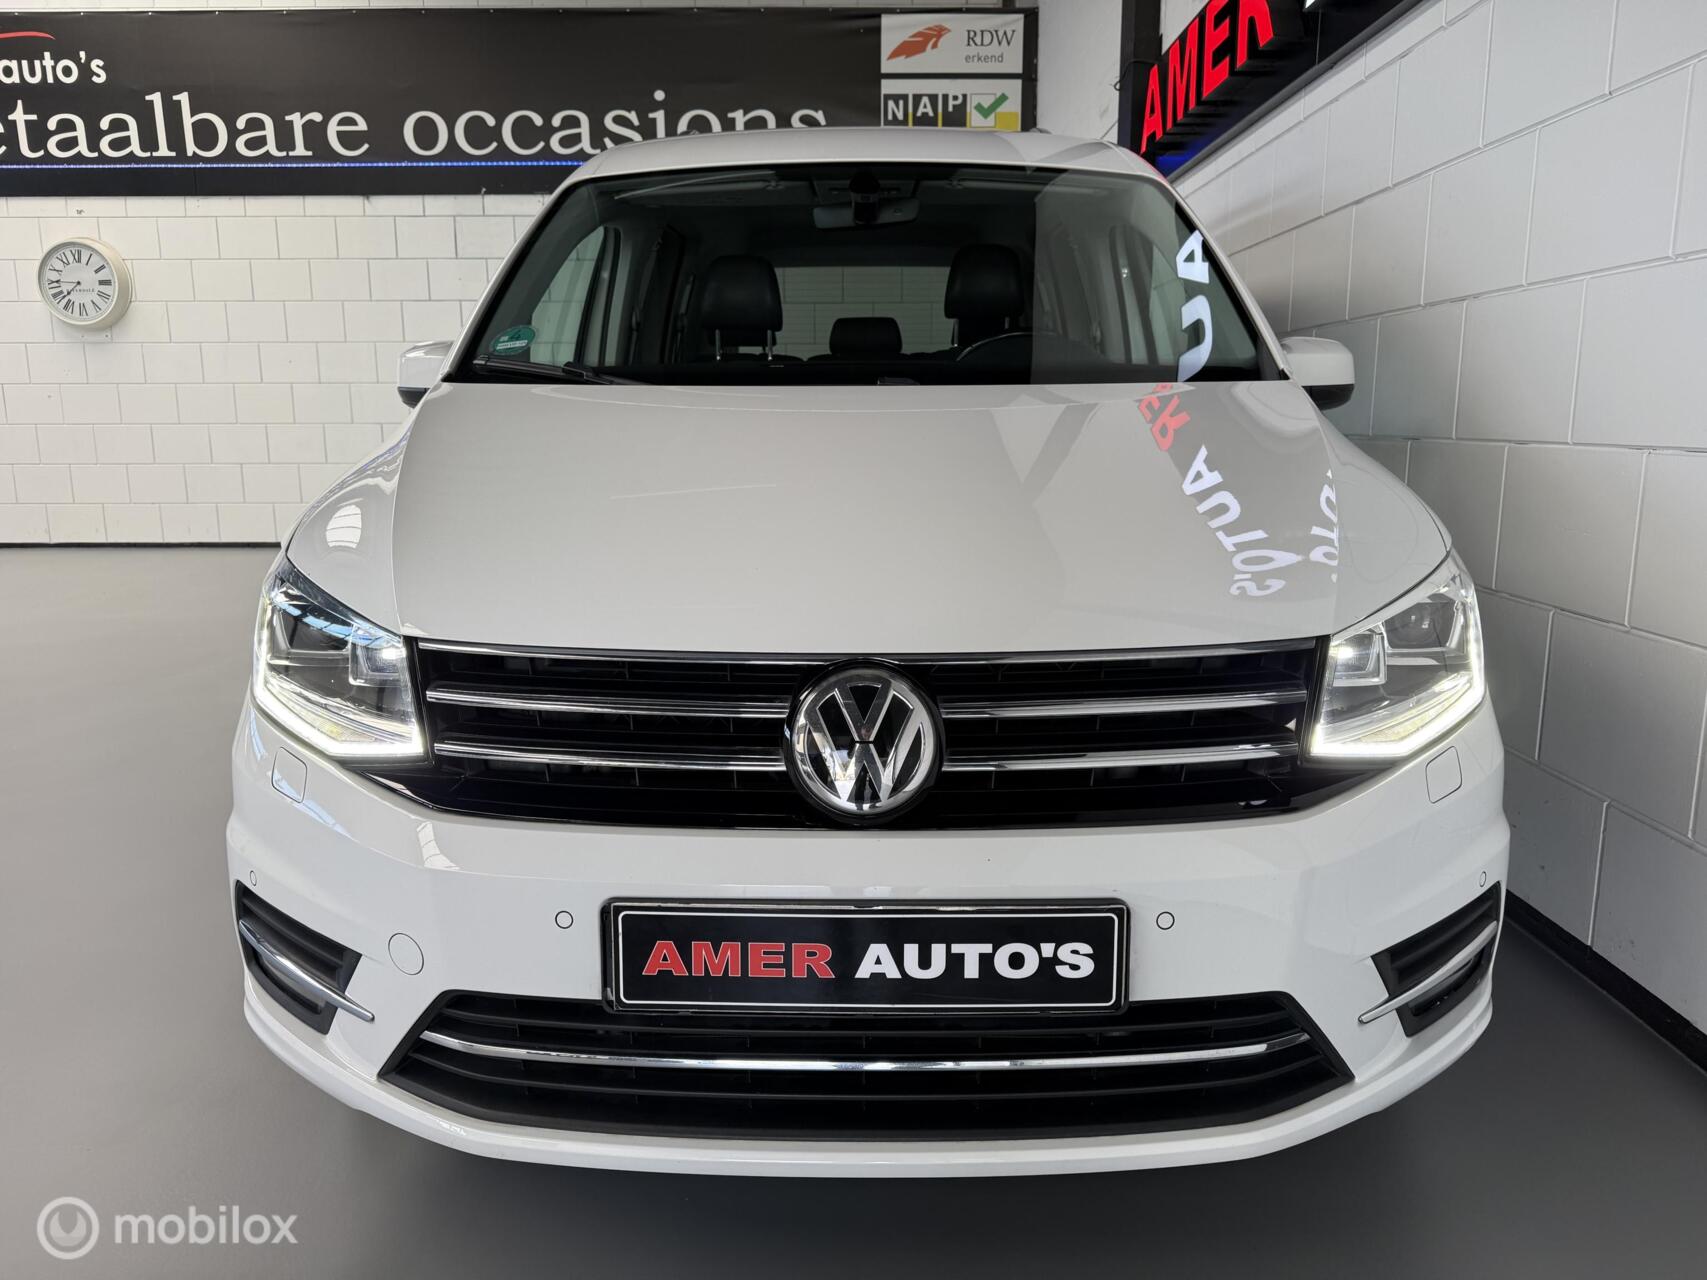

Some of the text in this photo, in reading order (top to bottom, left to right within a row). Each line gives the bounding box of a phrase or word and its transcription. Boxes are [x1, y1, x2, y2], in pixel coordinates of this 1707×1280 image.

[966, 29, 1016, 47] RDW
[0, 51, 107, 84] auto's
[965, 52, 1004, 63] erkend
[0, 91, 370, 158] taalbare
[642, 940, 1096, 979] AMER AUTO'S
